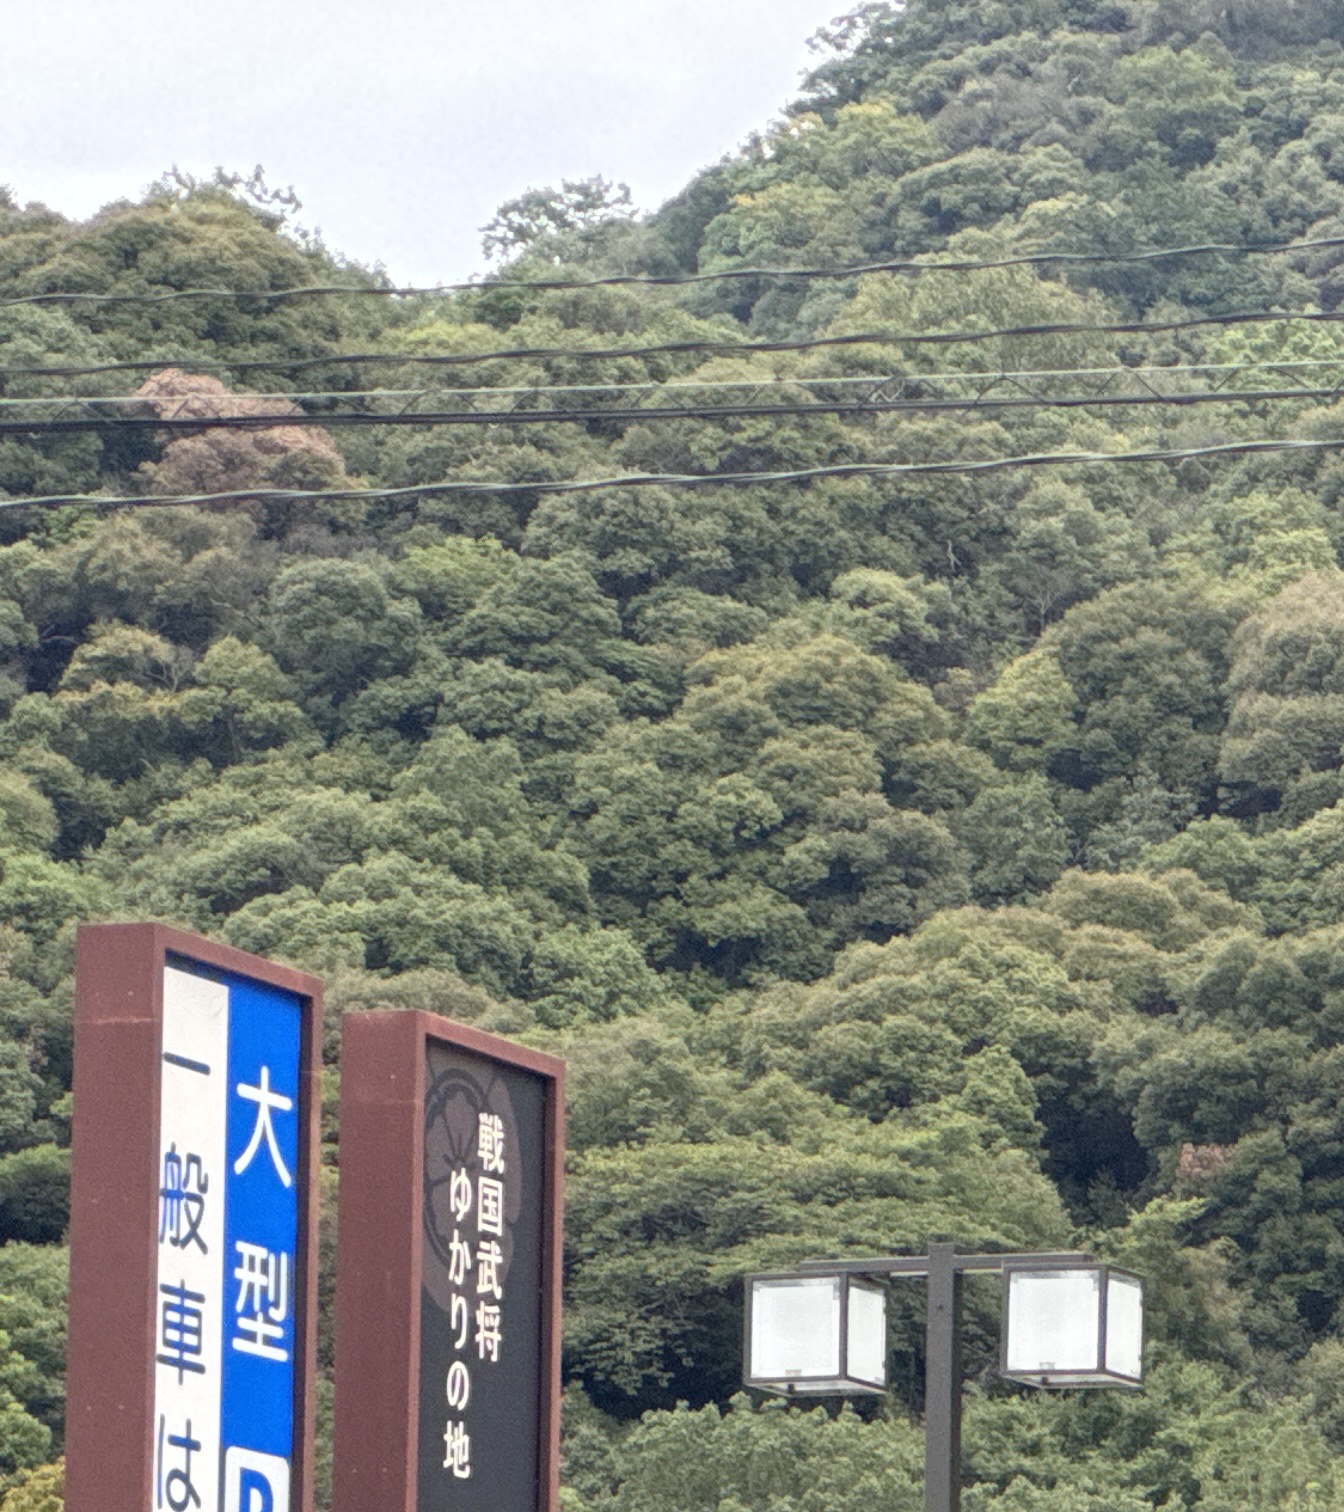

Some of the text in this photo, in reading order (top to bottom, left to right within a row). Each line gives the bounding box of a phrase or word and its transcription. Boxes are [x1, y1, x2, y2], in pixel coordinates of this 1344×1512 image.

[233, 1066, 293, 1362] 大型
[443, 1169, 471, 1480] ゆかりの地
[474, 1113, 504, 1363] 戦国武将
